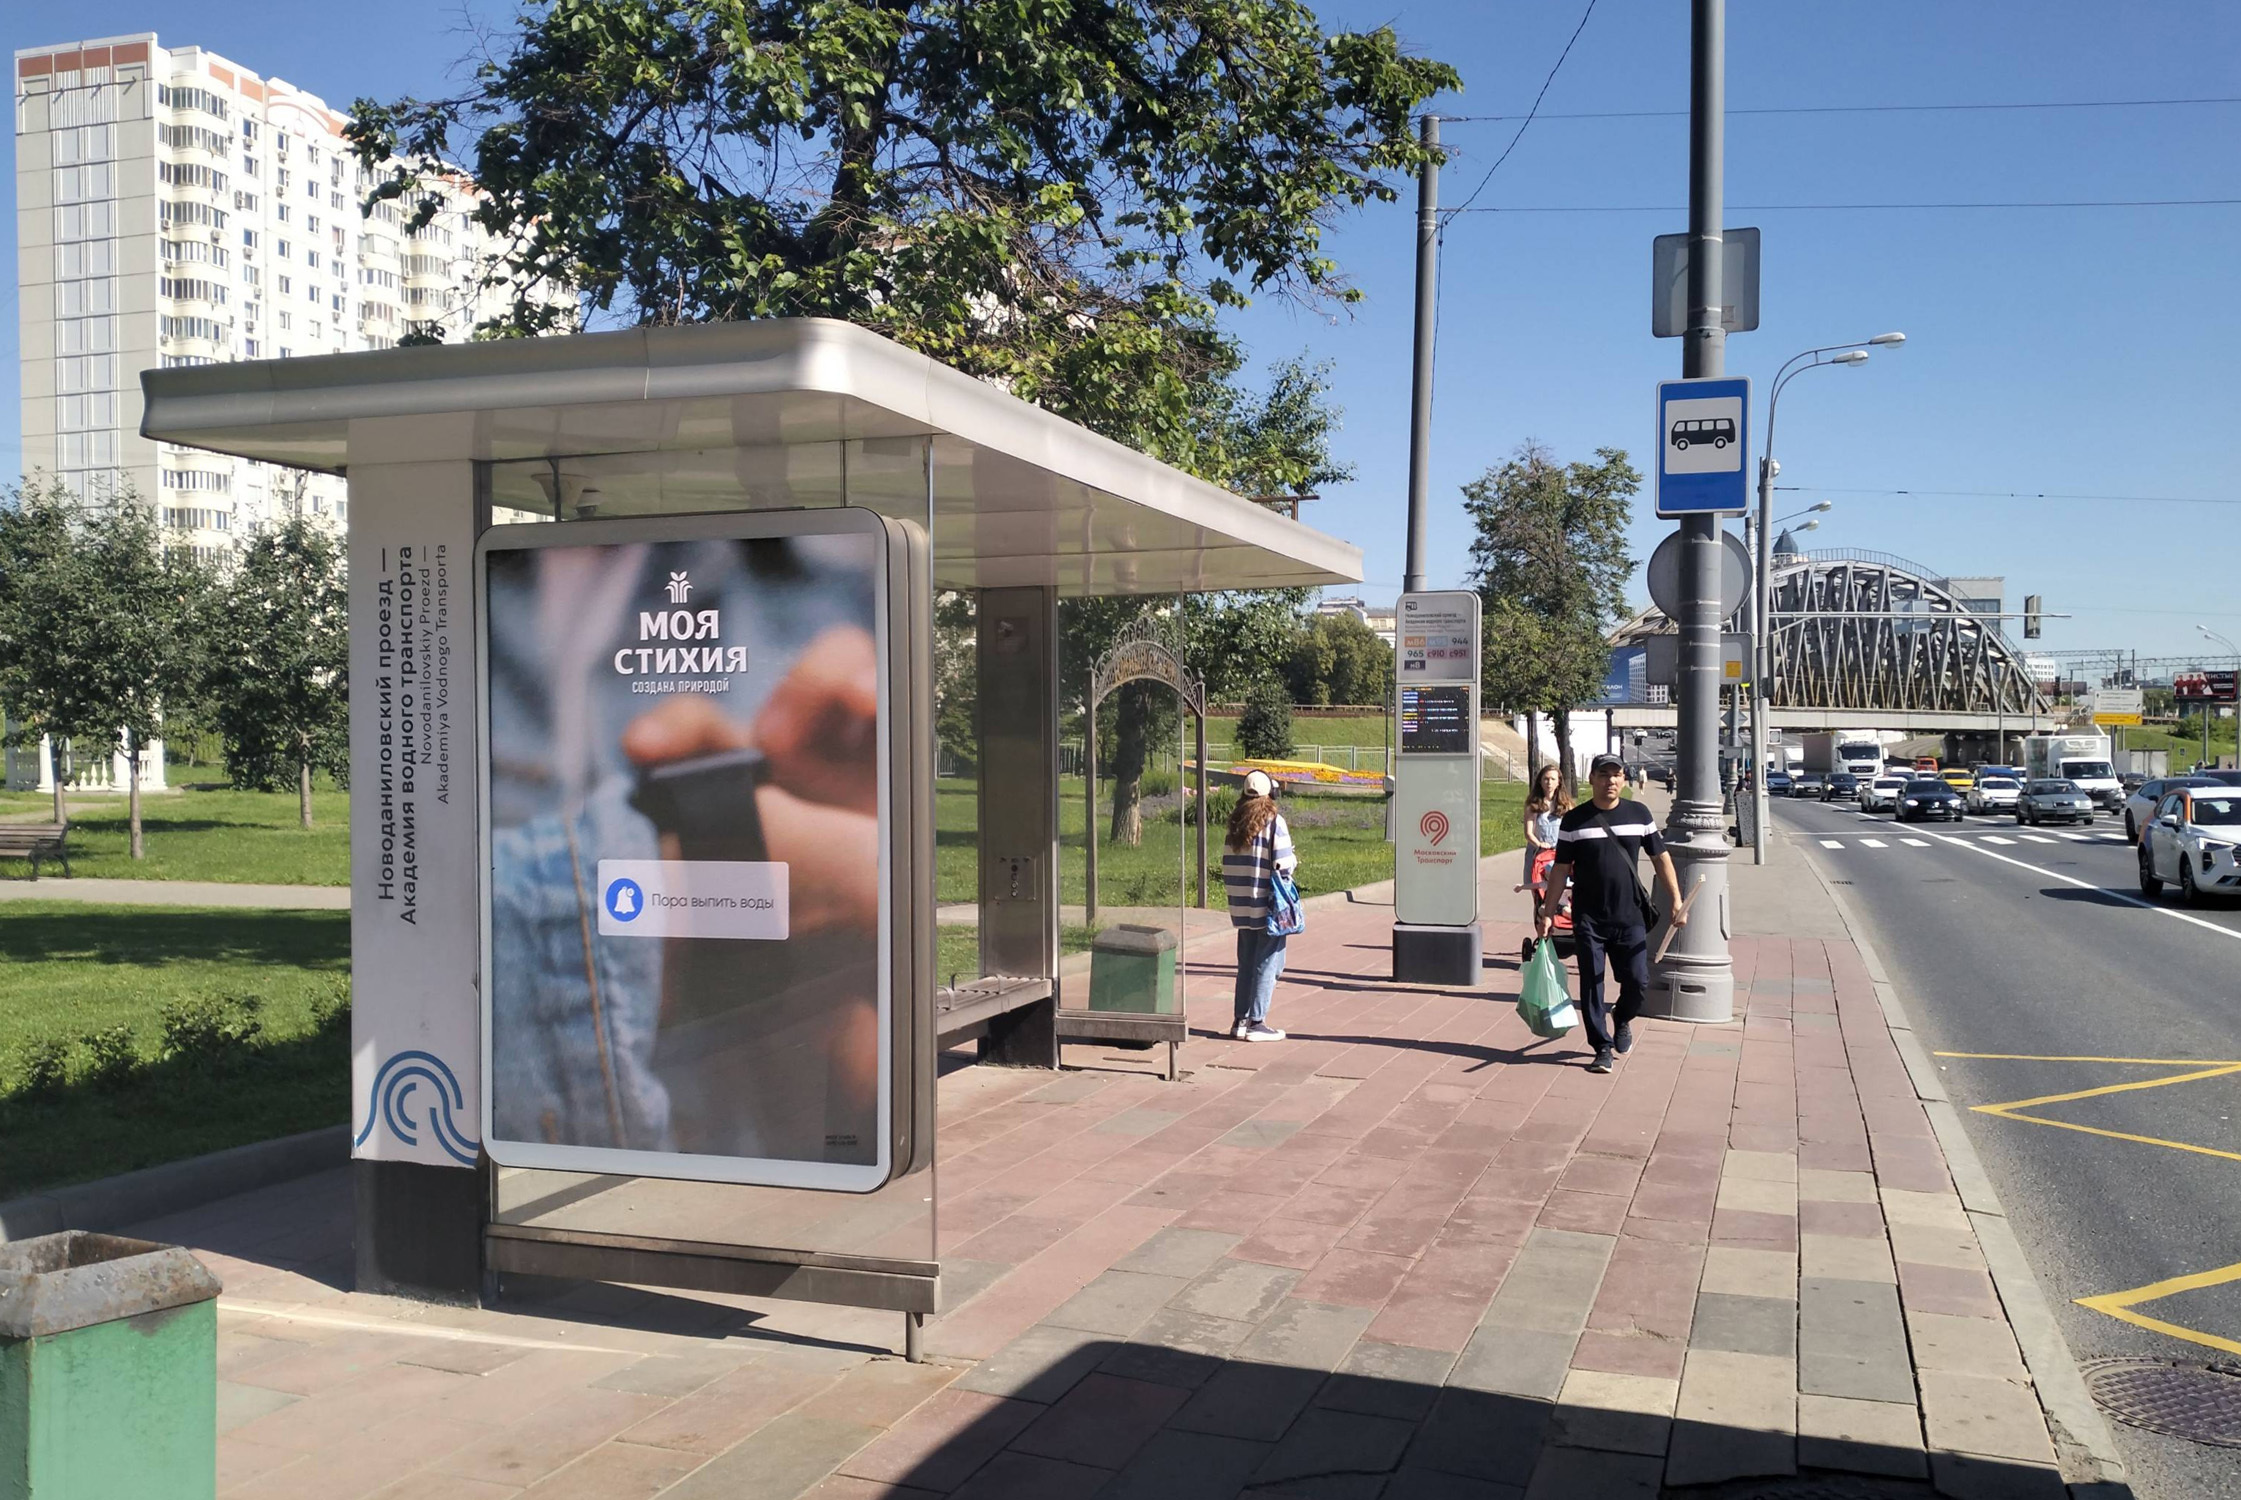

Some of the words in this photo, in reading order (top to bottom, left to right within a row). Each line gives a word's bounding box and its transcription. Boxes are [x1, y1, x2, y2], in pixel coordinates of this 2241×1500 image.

[379, 580, 395, 668] проезд
[400, 546, 417, 688] транспорта
[418, 568, 431, 624] Proezd
[436, 545, 449, 631] Transporta
[639, 609, 719, 641] МОЯ
[436, 636, 450, 708] Vodnogo
[614, 646, 747, 675] СТИХИЯ
[1407, 637, 1425, 647] м86
[1451, 637, 1468, 645] 944
[1407, 650, 1424, 658] 965
[419, 629, 433, 764] Novodanilovskiy
[631, 681, 676, 695] СОЗДАНА
[678, 677, 730, 694] ПРИРОДОЙ
[401, 694, 416, 793] водного
[436, 713, 451, 804] Akademiya
[376, 676, 395, 900] Новоданиловский
[400, 802, 418, 925] Академия
[651, 893, 688, 909] Пора
[691, 896, 736, 908] выпить
[740, 896, 774, 911] воды
